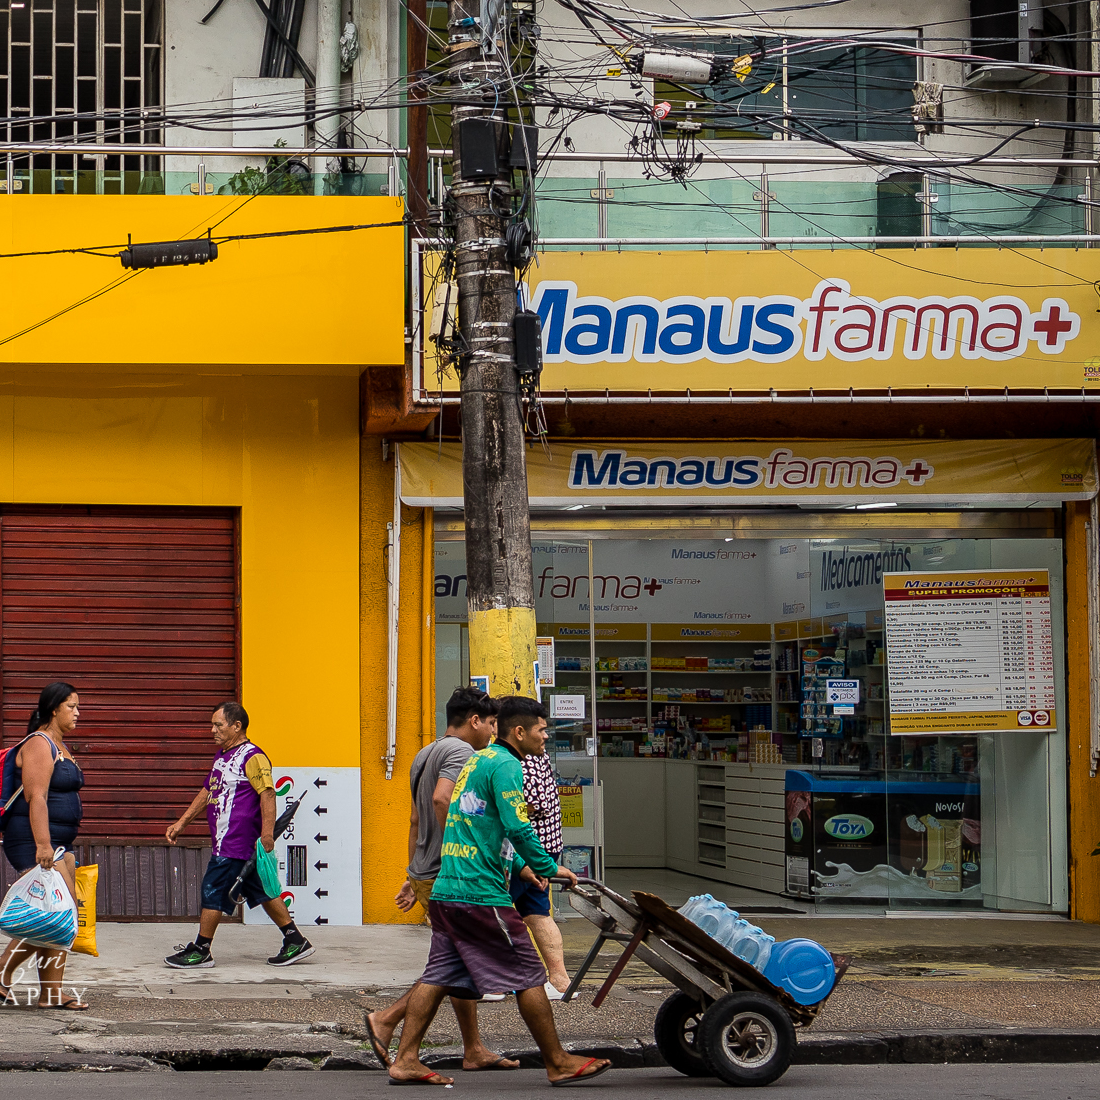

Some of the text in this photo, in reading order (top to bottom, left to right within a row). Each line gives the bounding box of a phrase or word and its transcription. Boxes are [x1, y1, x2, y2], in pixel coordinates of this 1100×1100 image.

[820, 541, 911, 592] Medicamentos
[951, 587, 1026, 595] PROMOÇÕES
[840, 692, 856, 701] pix
[558, 786, 582, 794] FERTA
